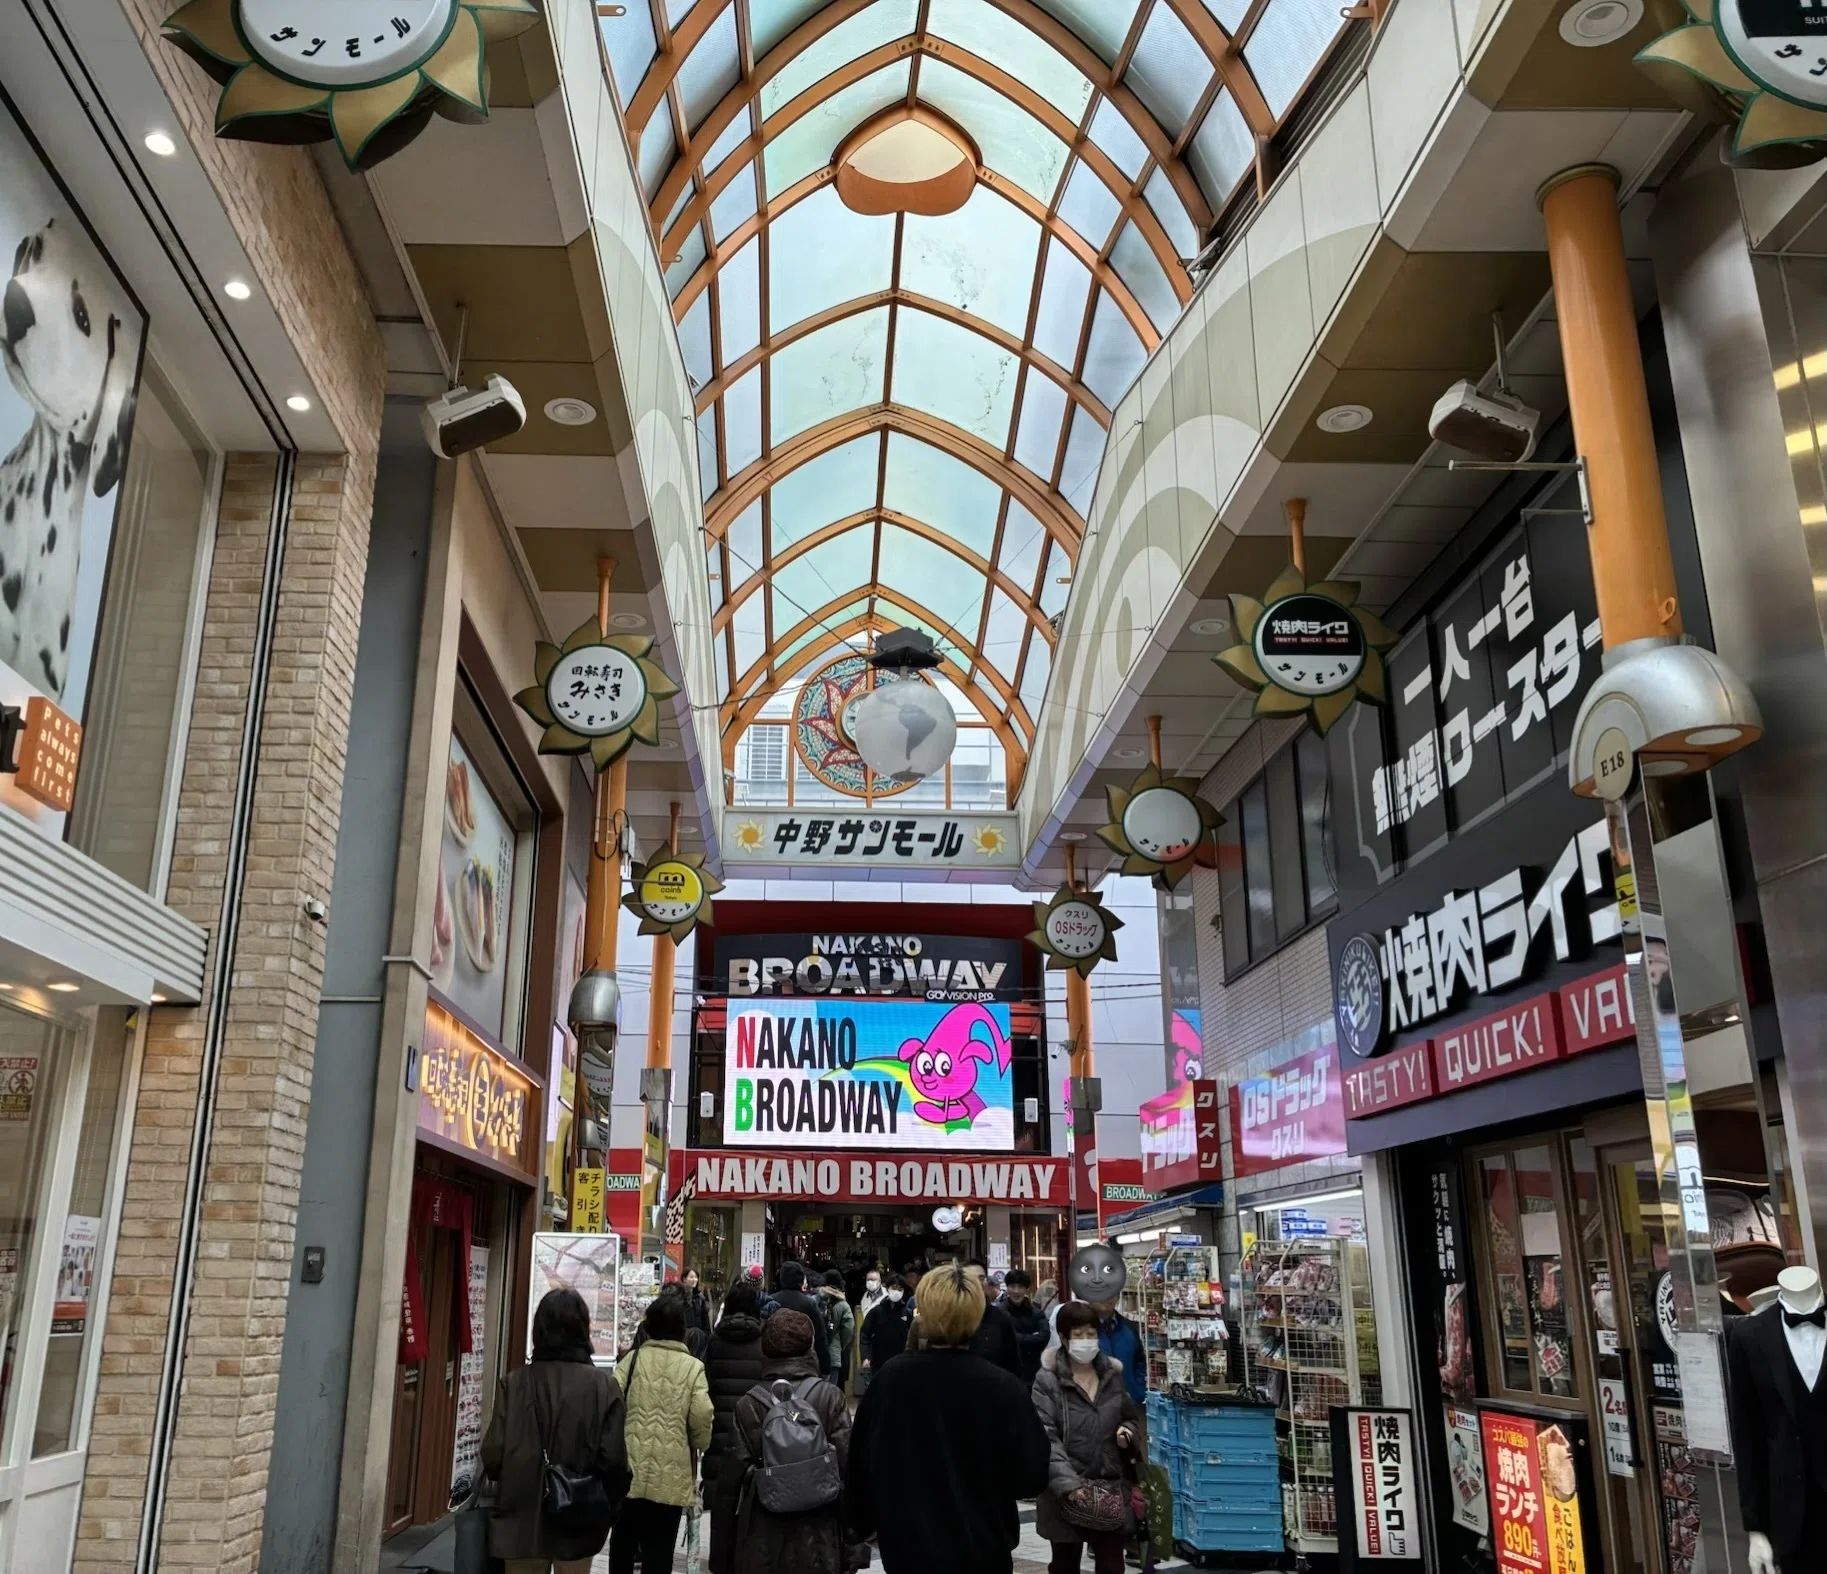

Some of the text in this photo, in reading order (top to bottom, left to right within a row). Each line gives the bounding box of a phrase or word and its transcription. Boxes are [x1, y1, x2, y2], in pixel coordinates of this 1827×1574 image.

[269, 16, 411, 58] サンモール
[569, 680, 622, 701] みさき
[571, 665, 624, 680] 回転寿司
[1277, 662, 1349, 685] サンモール
[43, 706, 80, 744] Pets
[557, 700, 619, 726] サンモール
[40, 729, 77, 764] always
[1600, 750, 1625, 780] E18
[32, 766, 71, 803] first
[36, 749, 74, 783] come
[773, 818, 964, 858] 中野サンモール
[1139, 838, 1190, 855] サンモール
[1055, 921, 1098, 938] OSドラッグ
[1064, 909, 1089, 919] クスリ
[812, 934, 923, 957] NAKANO
[728, 956, 1008, 996] BROADWAY
[736, 1015, 857, 1070] NAKANO
[1346, 1050, 1428, 1112] TASTY!
[1444, 1006, 1545, 1083] QUICK!
[734, 1077, 903, 1134] BROADWAY
[1243, 1054, 1331, 1130] OSドラッグ
[1196, 1091, 1218, 1170] クスリ
[1271, 1121, 1305, 1161] クスリ
[698, 1157, 841, 1196] NAKANO
[850, 1160, 1056, 1200] BROADWAY
[1360, 1418, 1380, 1554] TASTY! QUICK! VALUE!
[1497, 1445, 1531, 1489] 焼肉
[1495, 1483, 1539, 1524] ランチ
[1503, 1519, 1533, 1557] 890
